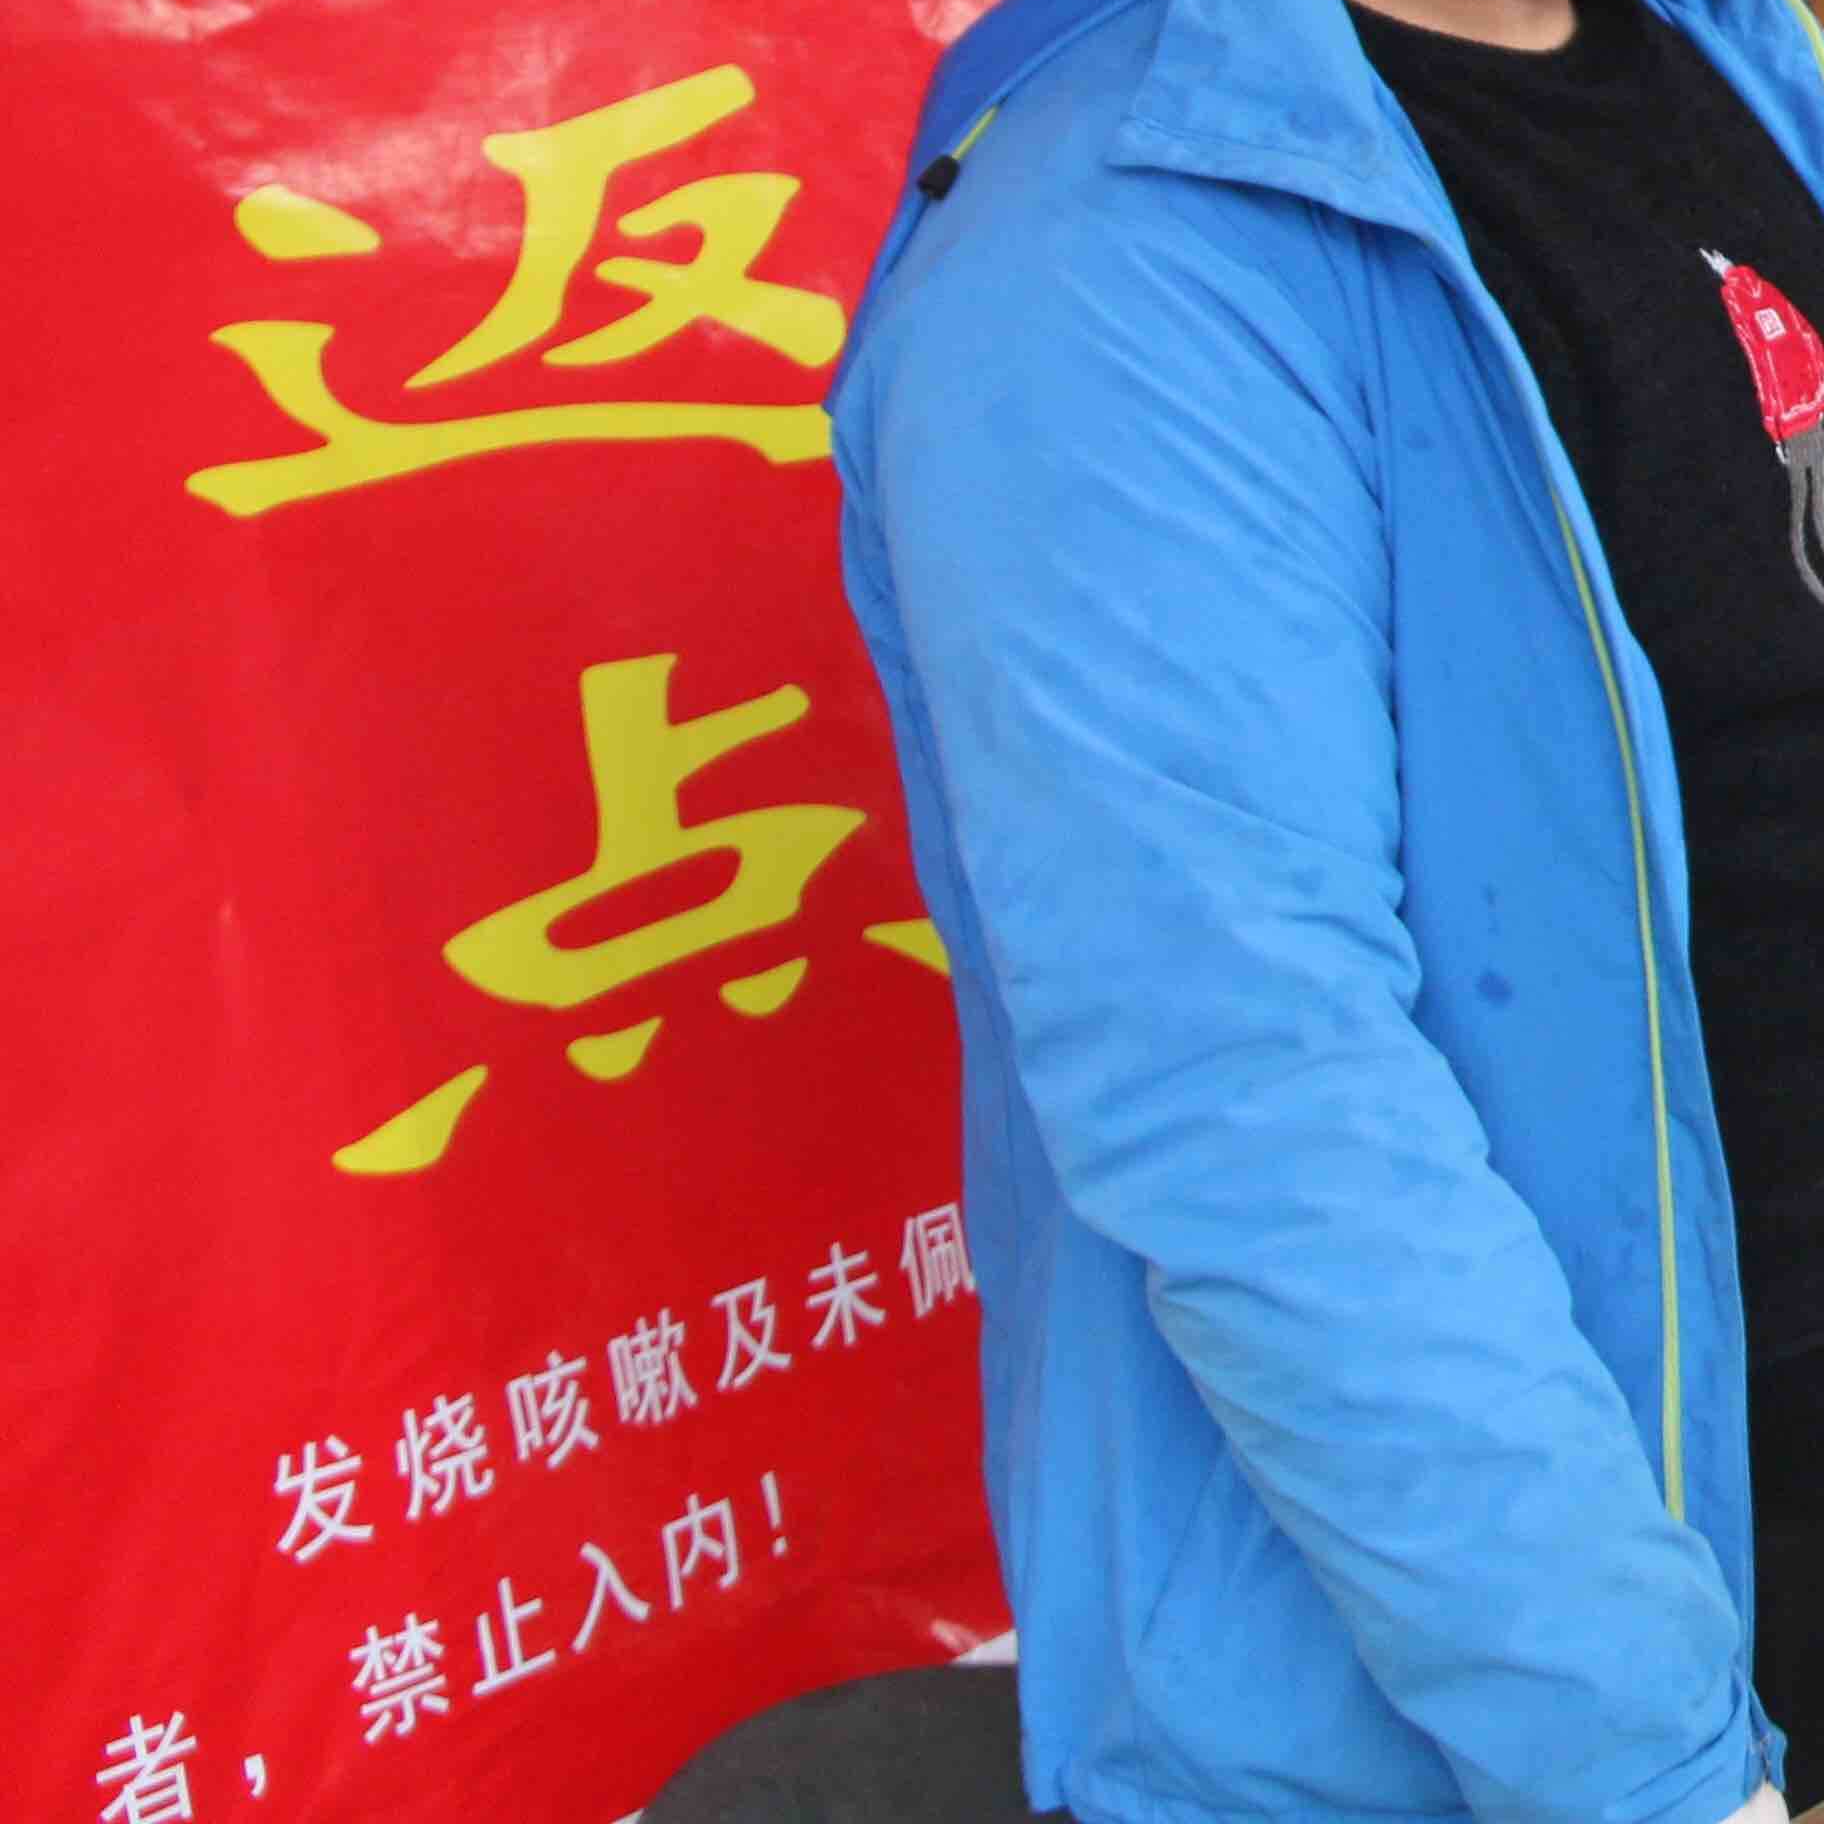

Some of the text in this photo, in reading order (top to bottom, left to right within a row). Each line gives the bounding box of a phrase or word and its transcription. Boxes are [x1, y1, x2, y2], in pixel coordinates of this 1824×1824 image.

[273, 1200, 977, 1564] 发烧咳嗽及未佩
